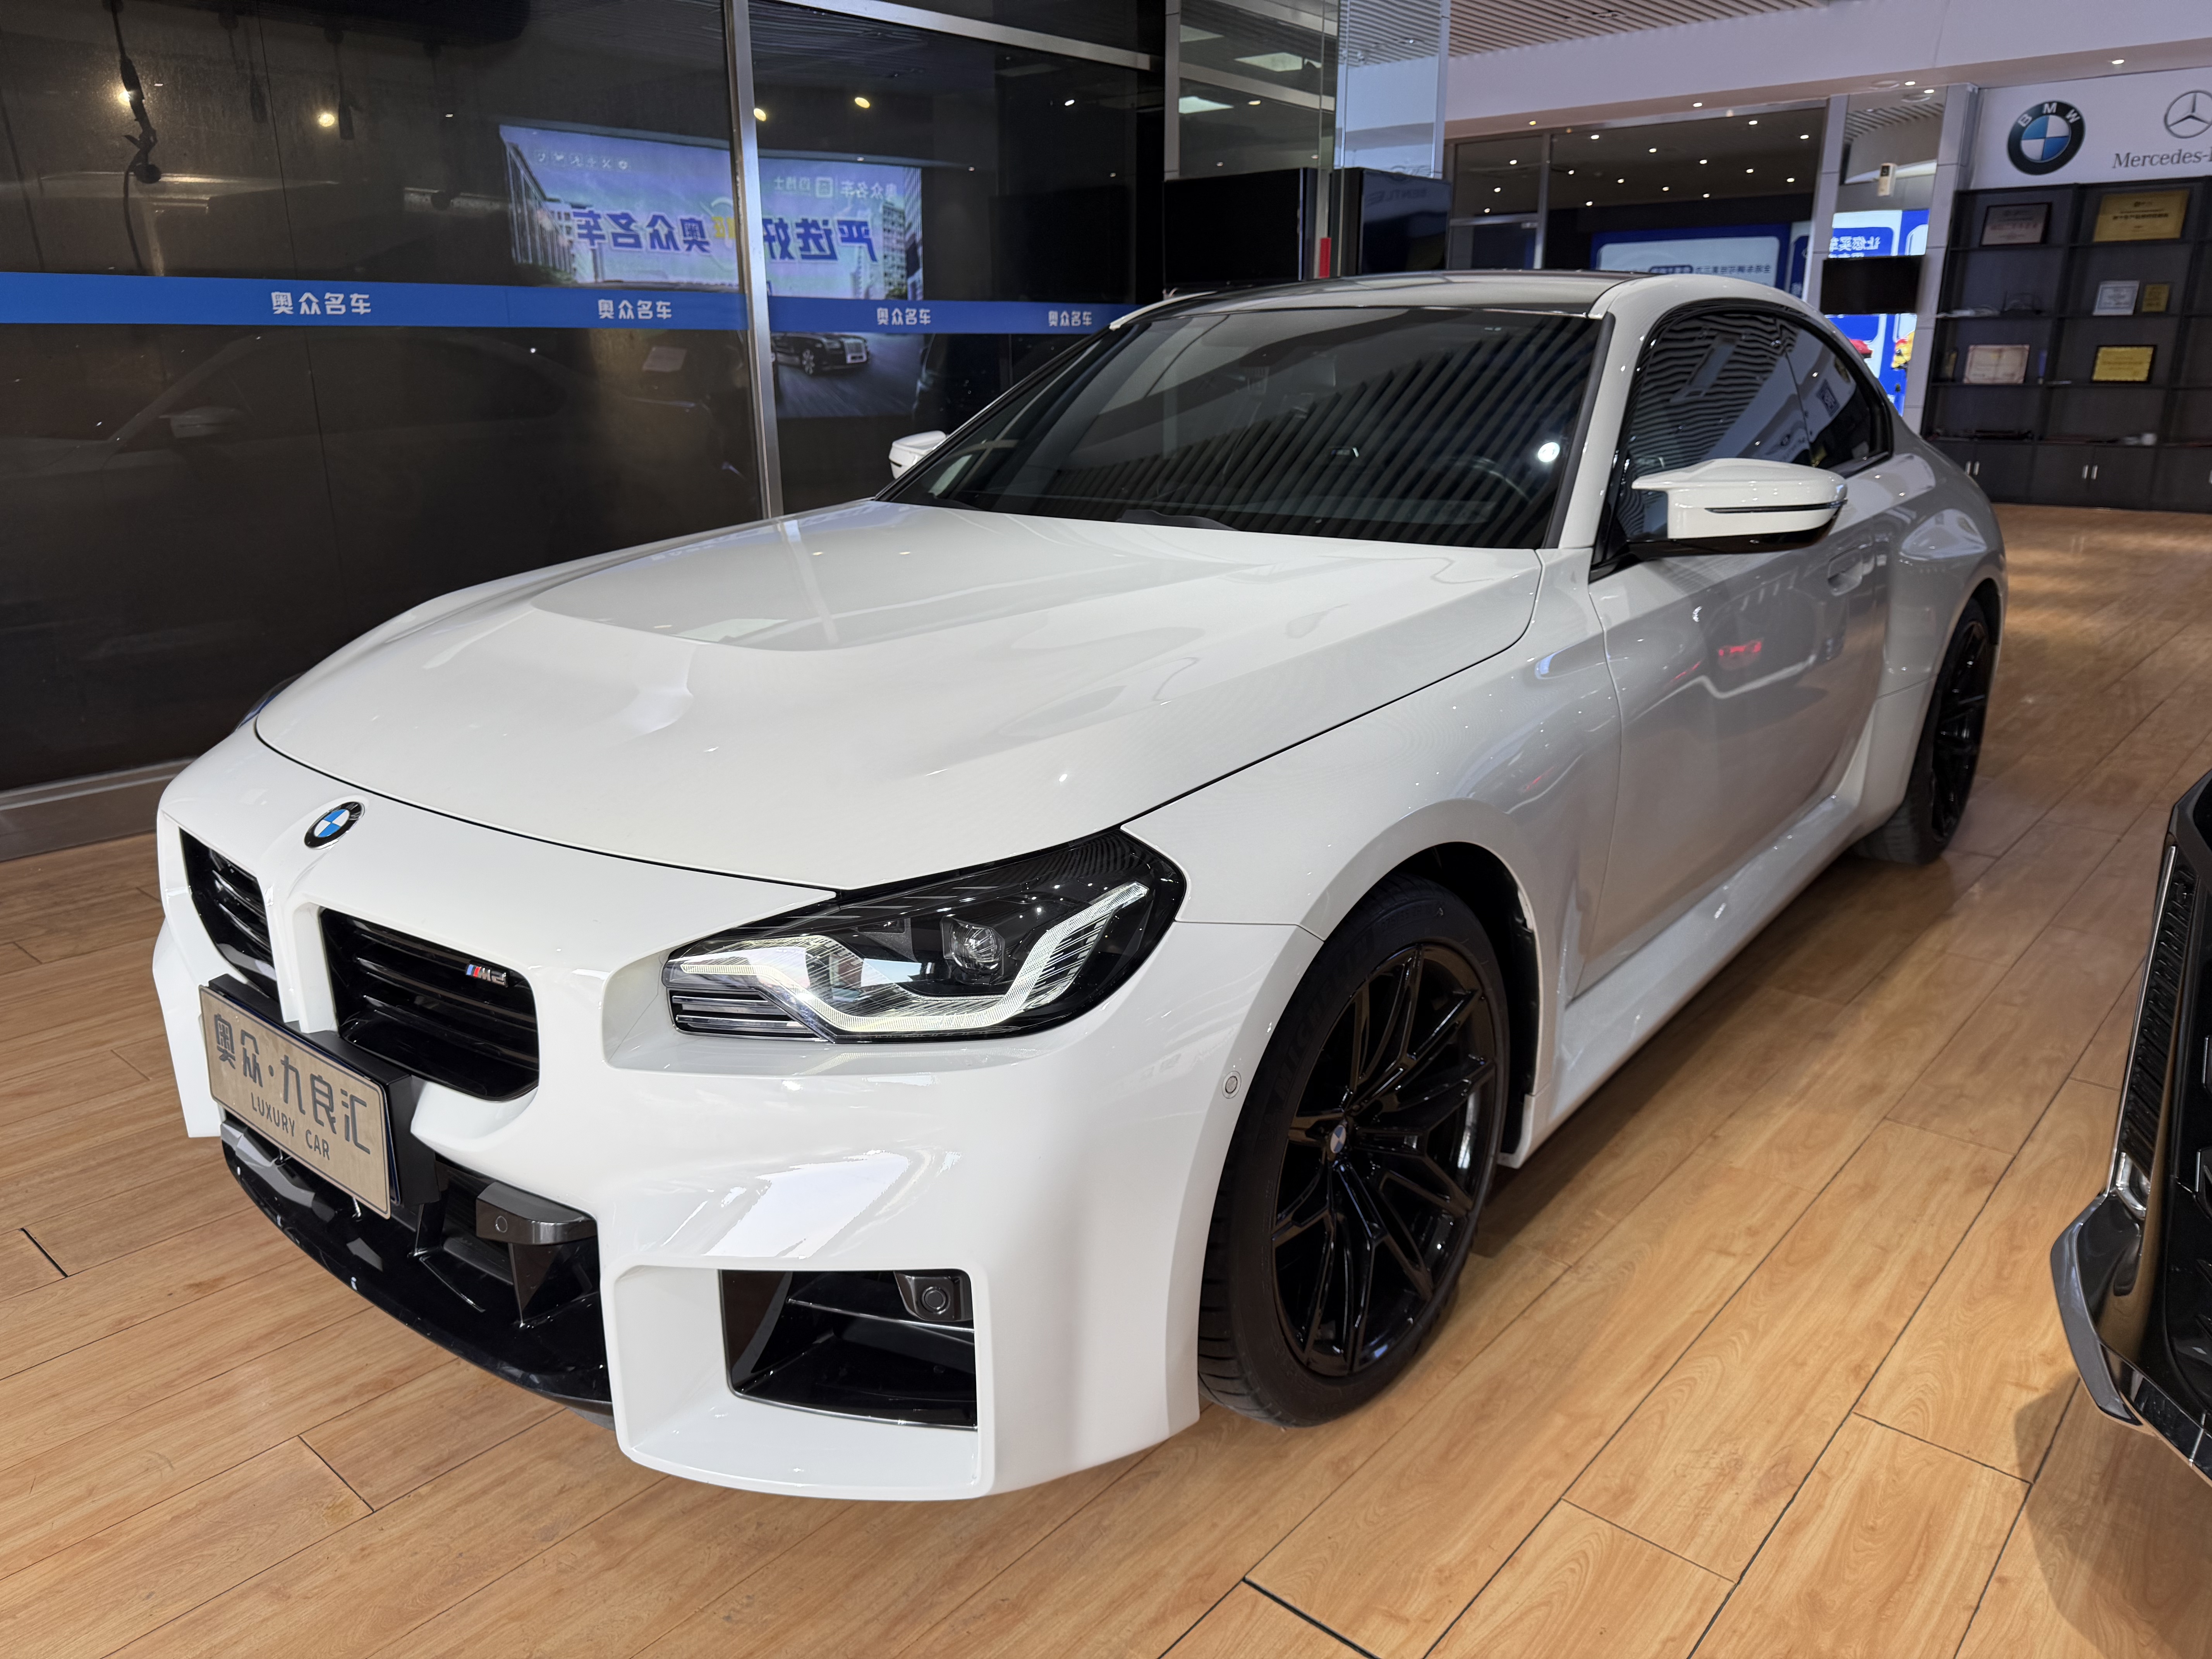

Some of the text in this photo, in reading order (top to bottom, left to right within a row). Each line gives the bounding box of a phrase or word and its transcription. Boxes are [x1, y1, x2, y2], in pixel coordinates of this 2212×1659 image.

[2018, 103, 2081, 127] BMW
[2112, 149, 2212, 168] Mercedes-
[271, 292, 371, 315] 奥众名车
[598, 299, 672, 319] 奥众名车
[877, 308, 931, 325] 奥众名车
[1049, 311, 1091, 326] 奥众名车
[477, 966, 508, 988] M2
[251, 1092, 330, 1161] LUXURY CAR
